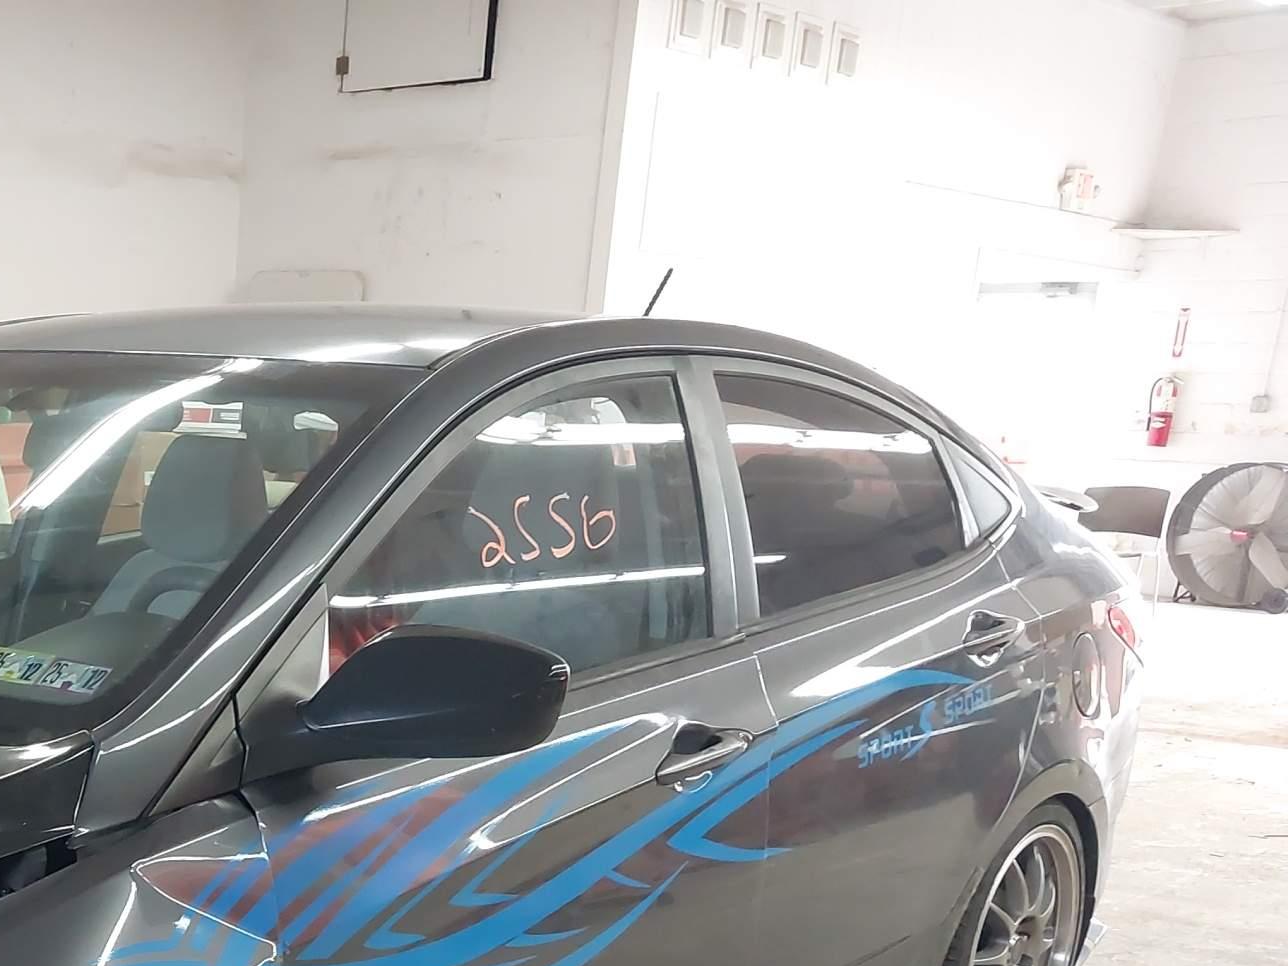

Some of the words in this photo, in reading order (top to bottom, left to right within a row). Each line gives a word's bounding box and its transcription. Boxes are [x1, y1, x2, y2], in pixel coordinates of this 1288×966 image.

[467, 492, 617, 568] 2556
[19, 662, 43, 682] 12
[42, 662, 69, 684] 25
[81, 668, 108, 690] 12
[944, 684, 994, 725] SPORT
[857, 725, 915, 768] SPORT
